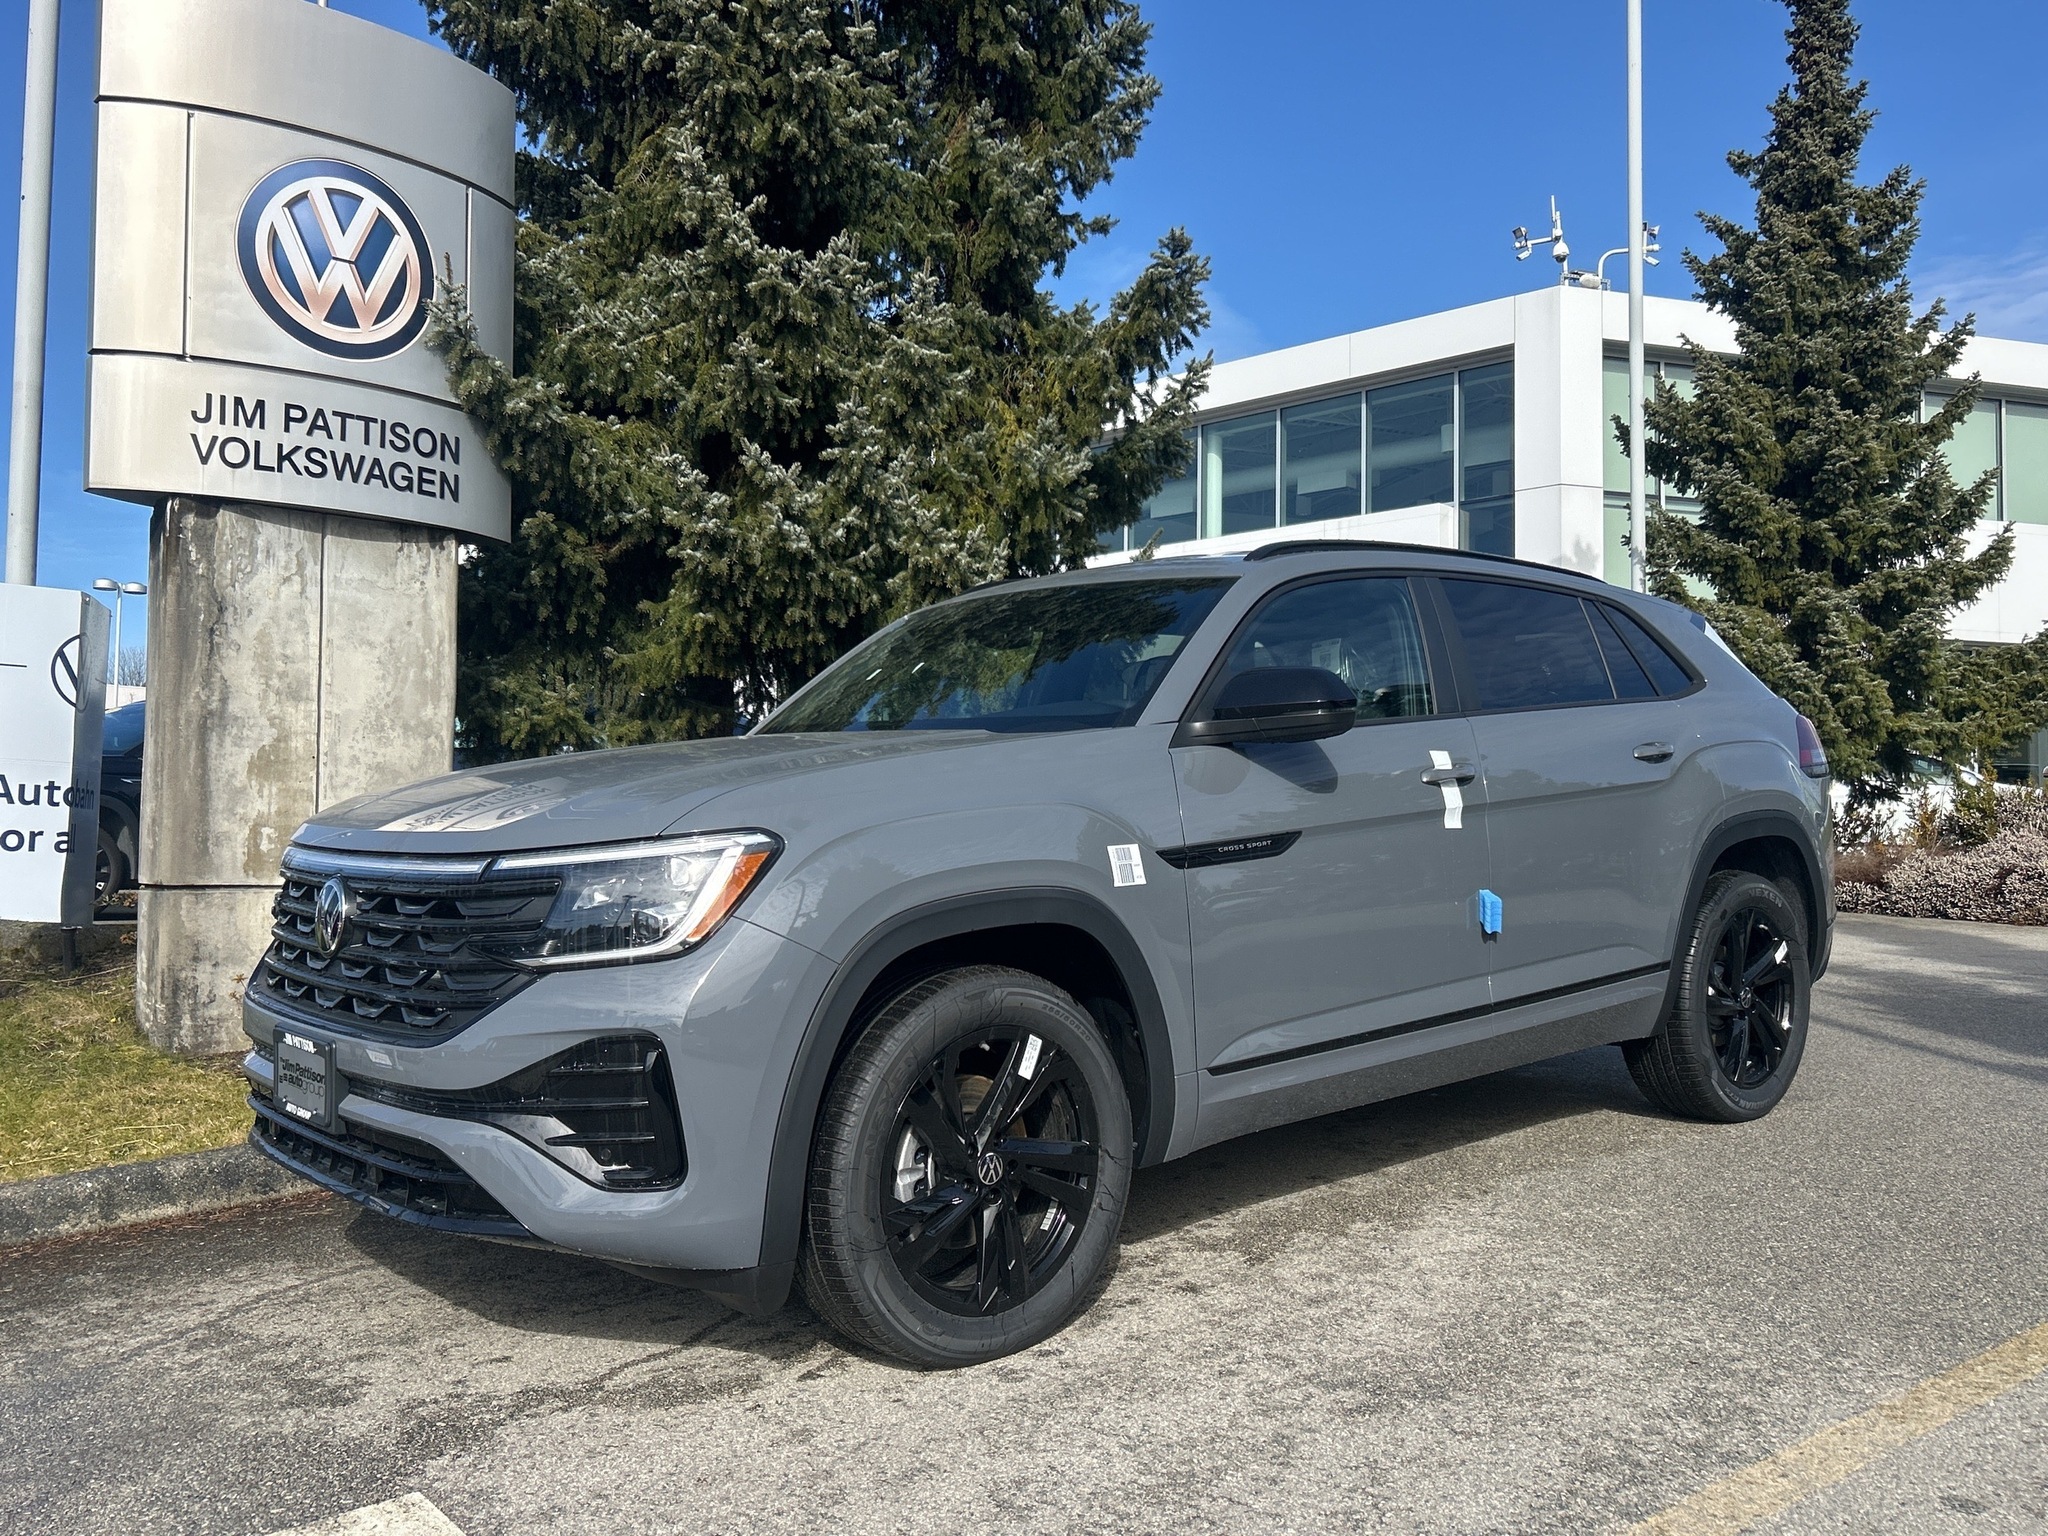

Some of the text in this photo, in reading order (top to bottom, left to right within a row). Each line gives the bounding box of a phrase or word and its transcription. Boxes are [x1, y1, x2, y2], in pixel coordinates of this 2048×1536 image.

[191, 393, 460, 465] JIM PATTISON
[190, 433, 460, 503] VOLKSWAGEN
[1218, 840, 1272, 853] CROSS SPORT
